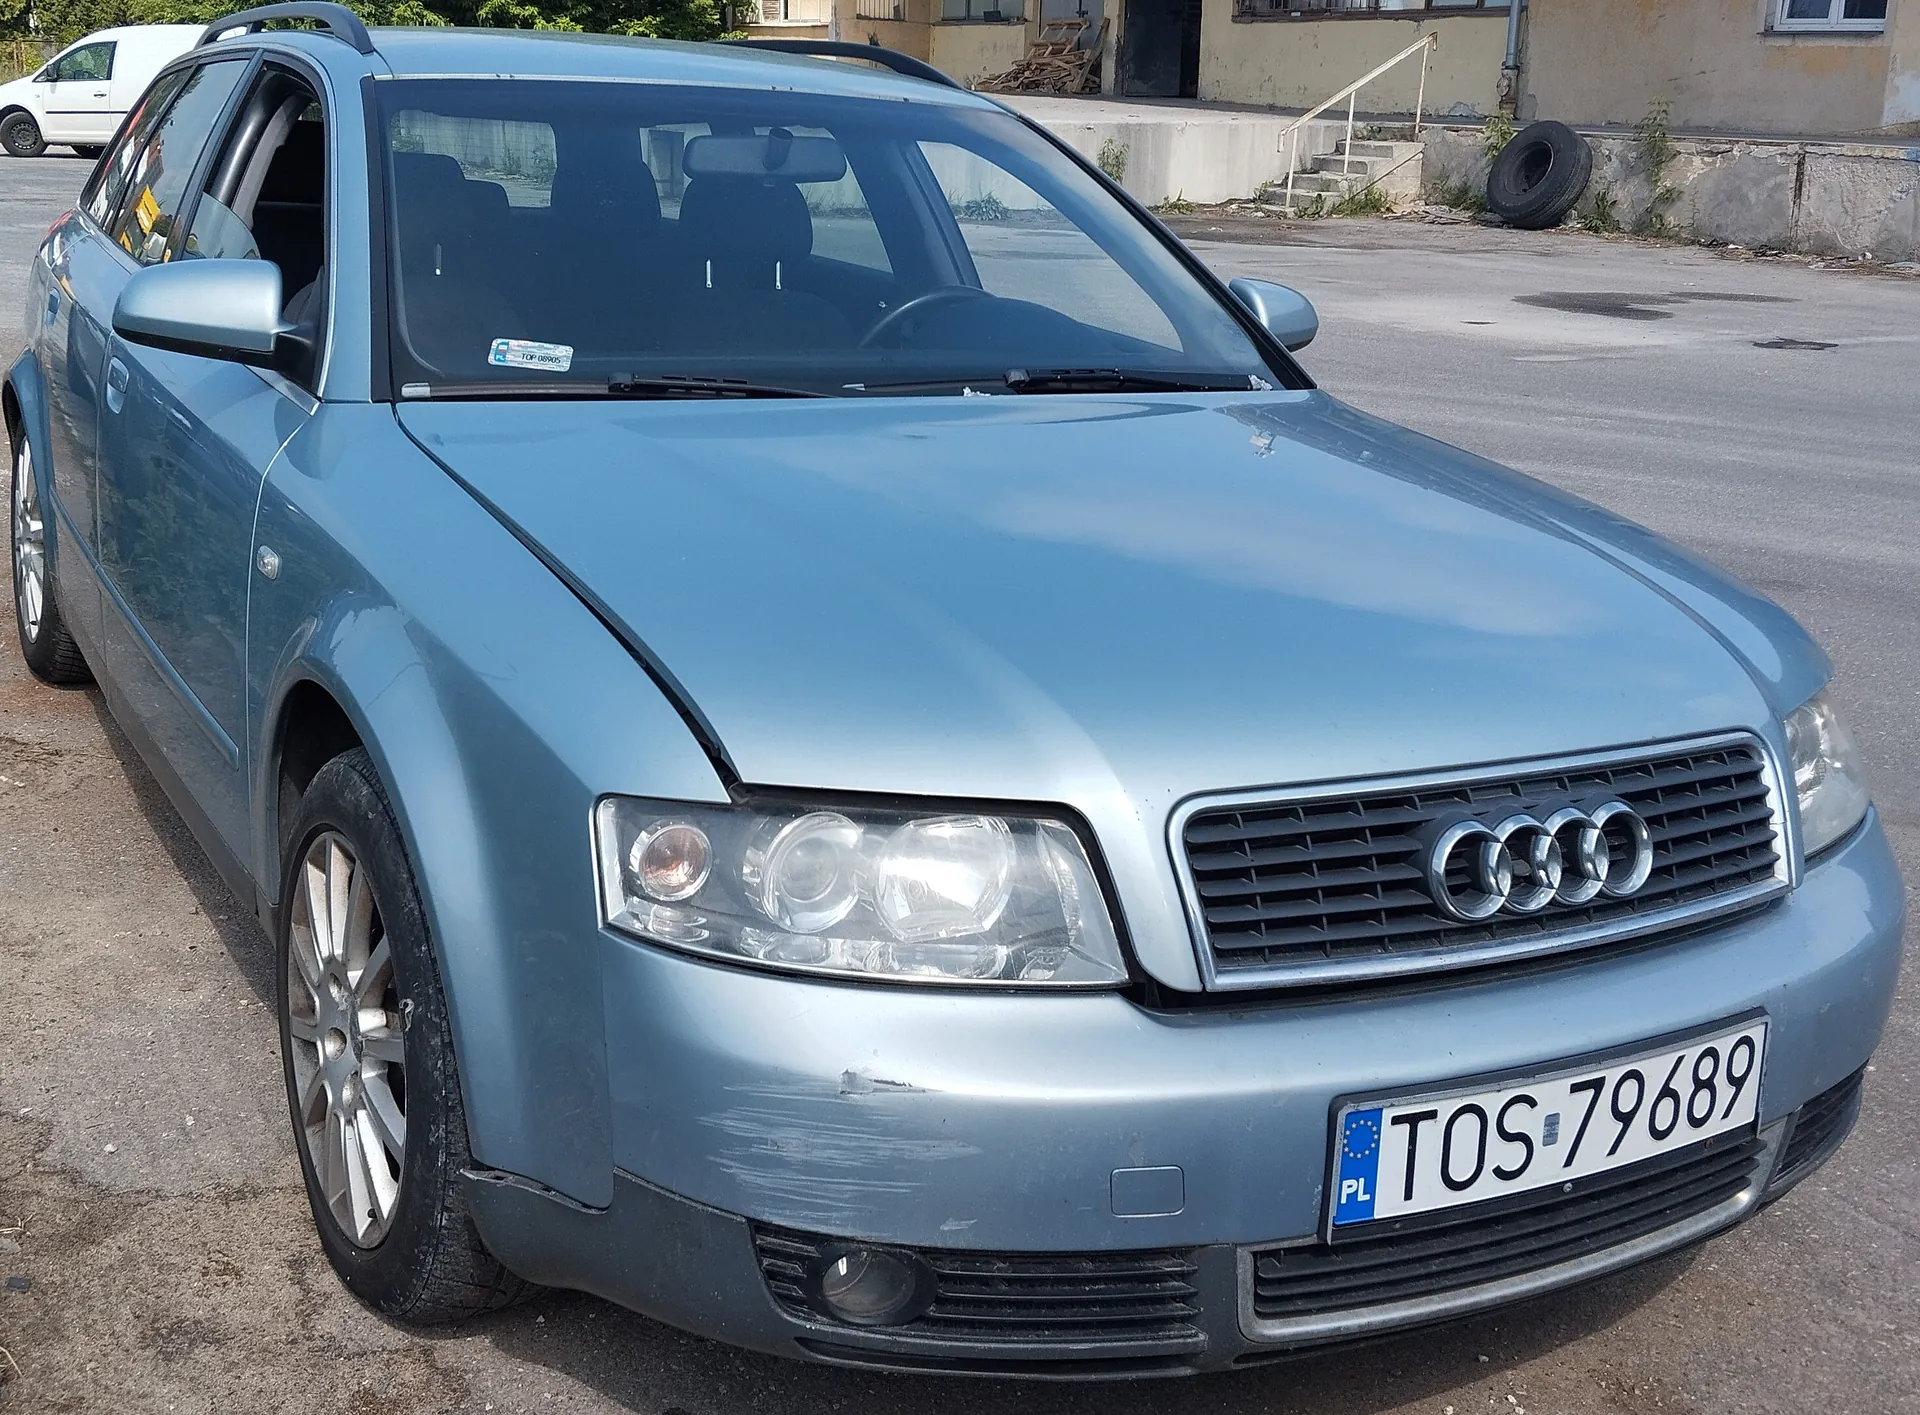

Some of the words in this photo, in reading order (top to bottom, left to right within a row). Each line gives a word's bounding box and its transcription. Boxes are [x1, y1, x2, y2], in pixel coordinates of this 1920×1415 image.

[521, 353, 537, 361] TOP
[537, 355, 561, 364] 08905
[1390, 1093, 1539, 1202] TOS
[1562, 1034, 1756, 1168] 79689
[1340, 1178, 1371, 1205] PL
